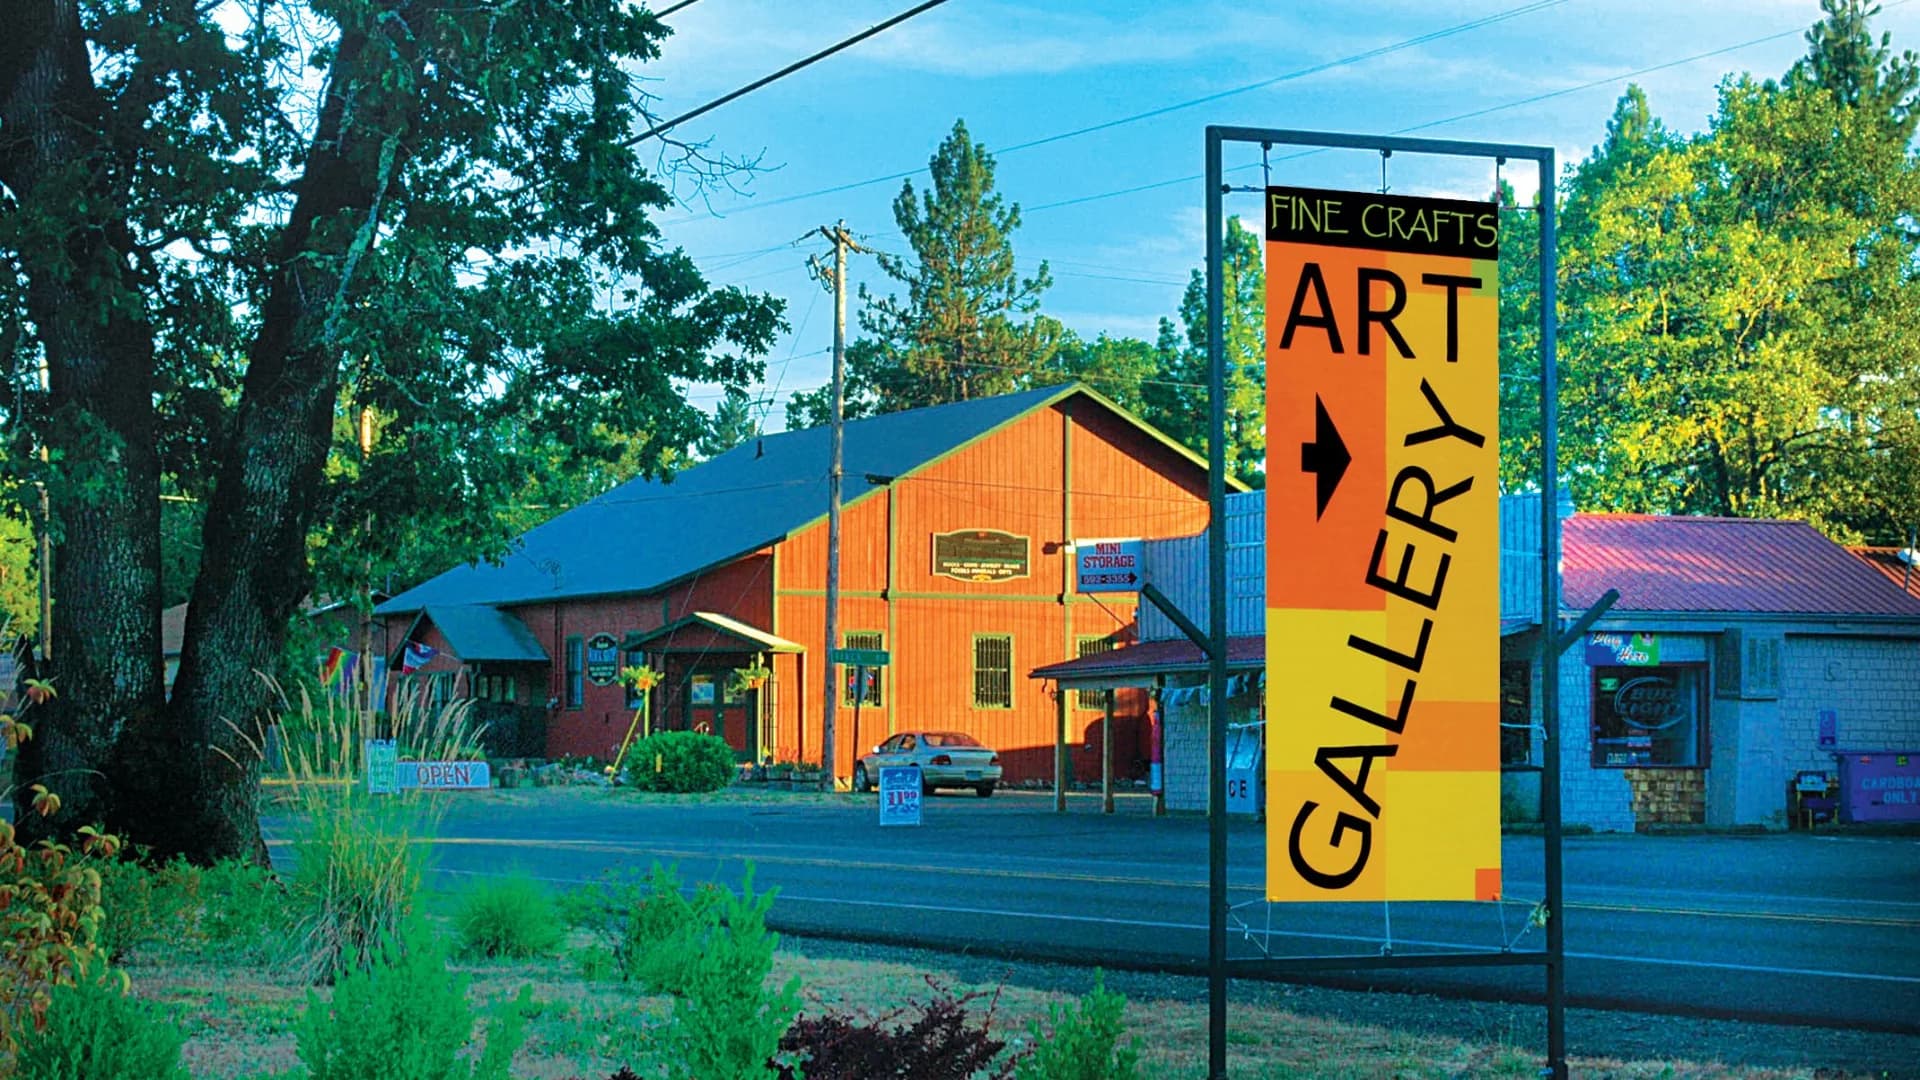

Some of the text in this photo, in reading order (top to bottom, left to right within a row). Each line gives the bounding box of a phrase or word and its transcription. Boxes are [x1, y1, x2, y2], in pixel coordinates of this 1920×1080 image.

[1271, 194, 1498, 248] FINE CRAFTS
[1279, 262, 1483, 363] ART
[1096, 543, 1121, 554] MINI
[1083, 555, 1135, 569] STORAGE
[1288, 376, 1486, 890] GALLERY
[1590, 631, 1621, 651] Play
[1616, 644, 1649, 663] Here
[417, 764, 470, 785] OPEN
[1228, 780, 1247, 798] CE
[1883, 790, 1917, 804] ONLY
